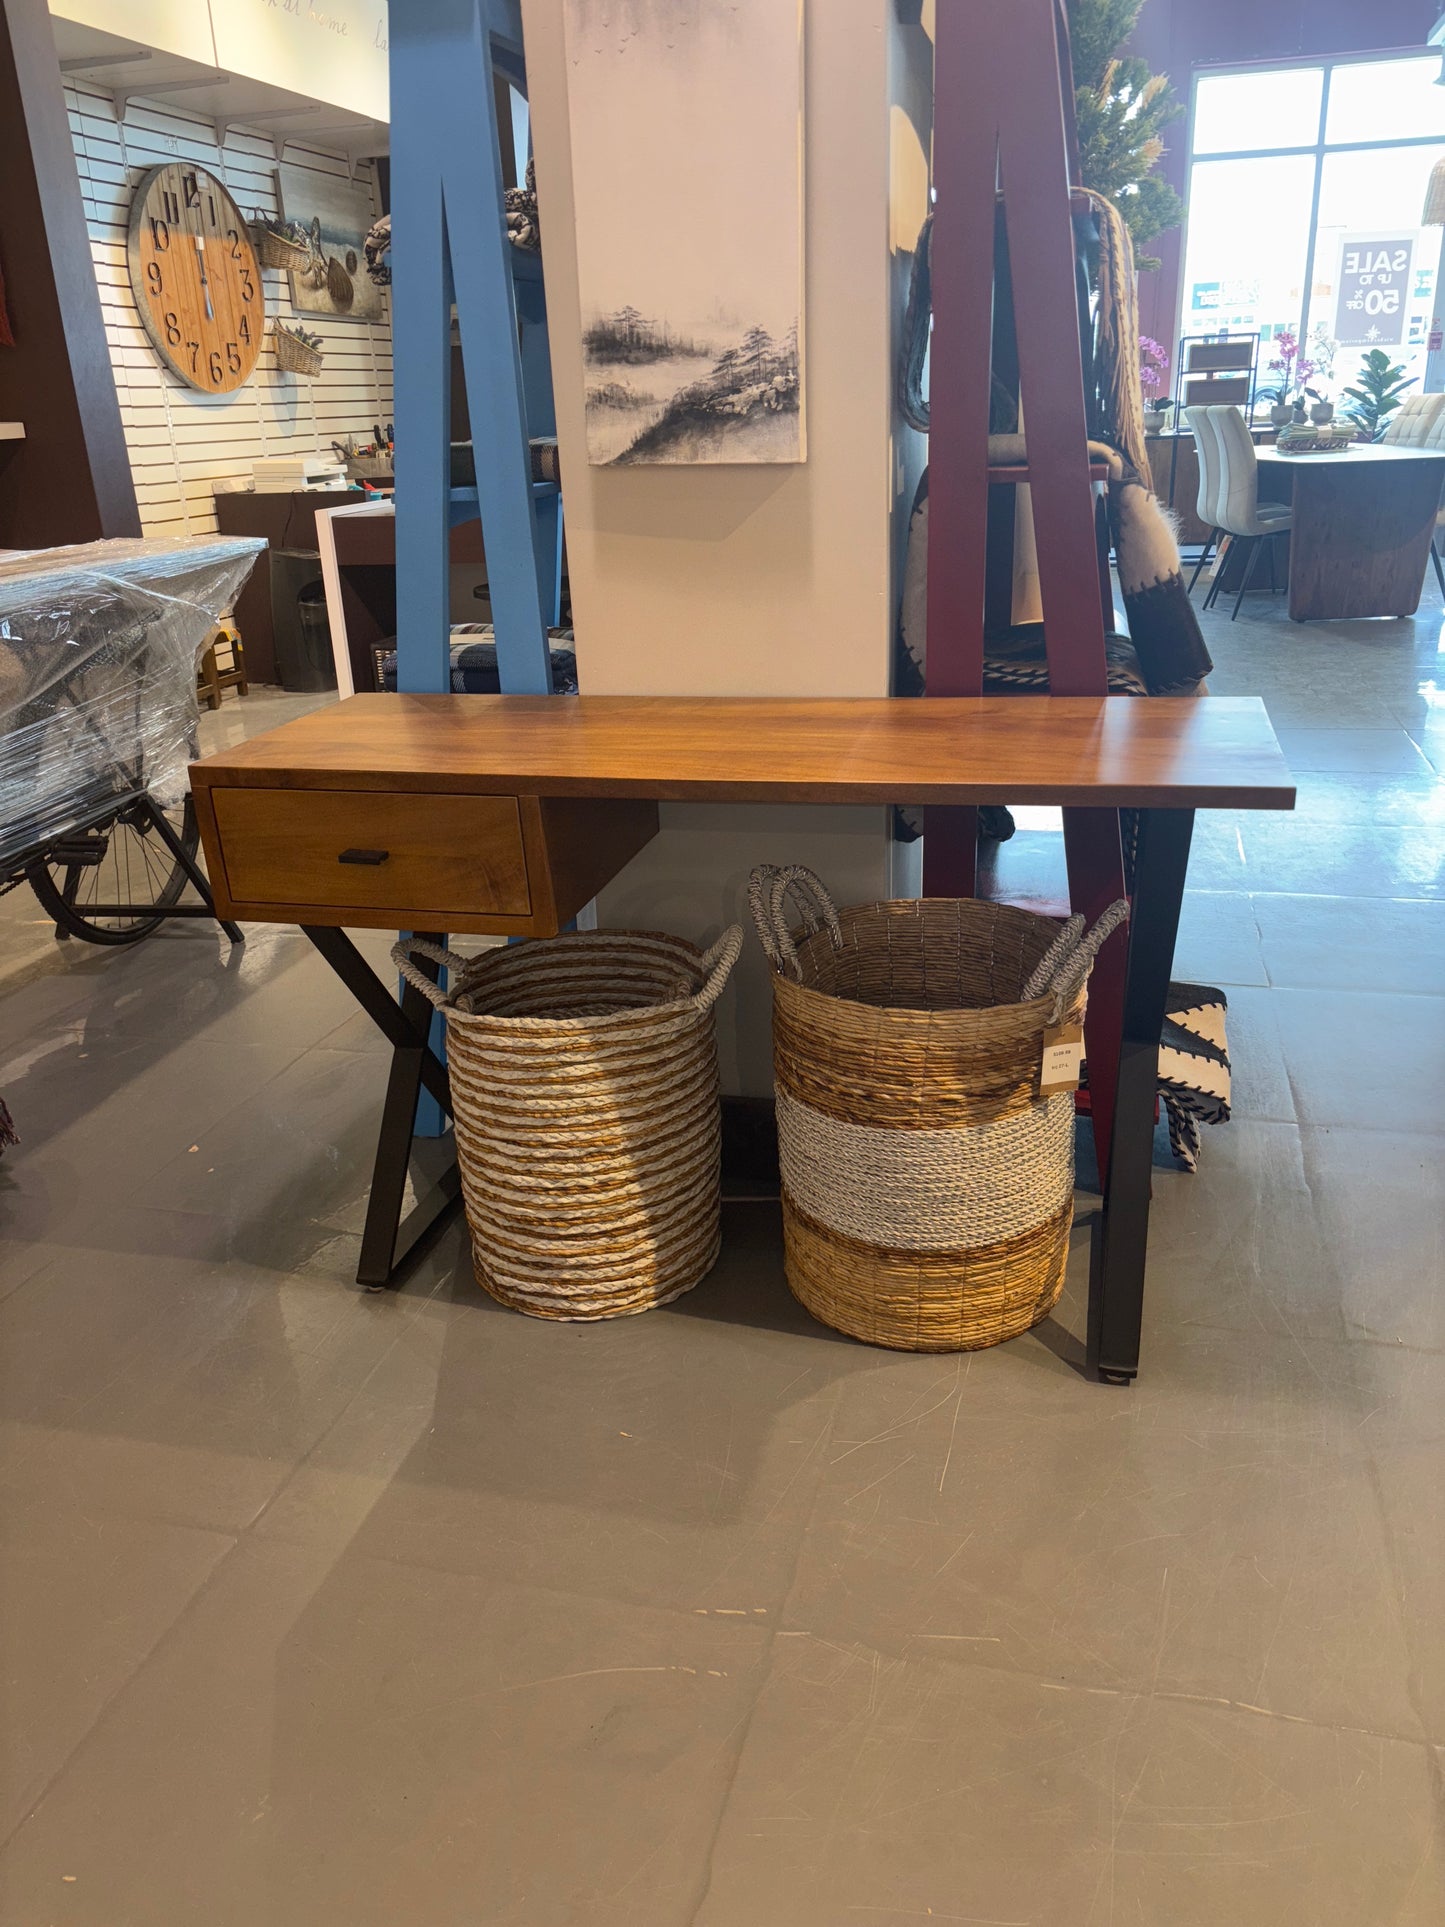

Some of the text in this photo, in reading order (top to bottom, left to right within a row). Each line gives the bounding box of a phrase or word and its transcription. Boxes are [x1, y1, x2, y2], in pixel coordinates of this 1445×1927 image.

[163, 191, 180, 225] 11
[208, 195, 216, 227] 1
[149, 216, 170, 251] 10
[227, 229, 242, 260] 2
[148, 262, 163, 296] 9
[239, 268, 254, 303] 3
[165, 312, 181, 346] 8
[239, 314, 251, 346] 4
[186, 341, 200, 373] 7
[209, 352, 223, 385] 6
[226, 342, 242, 375] 5
